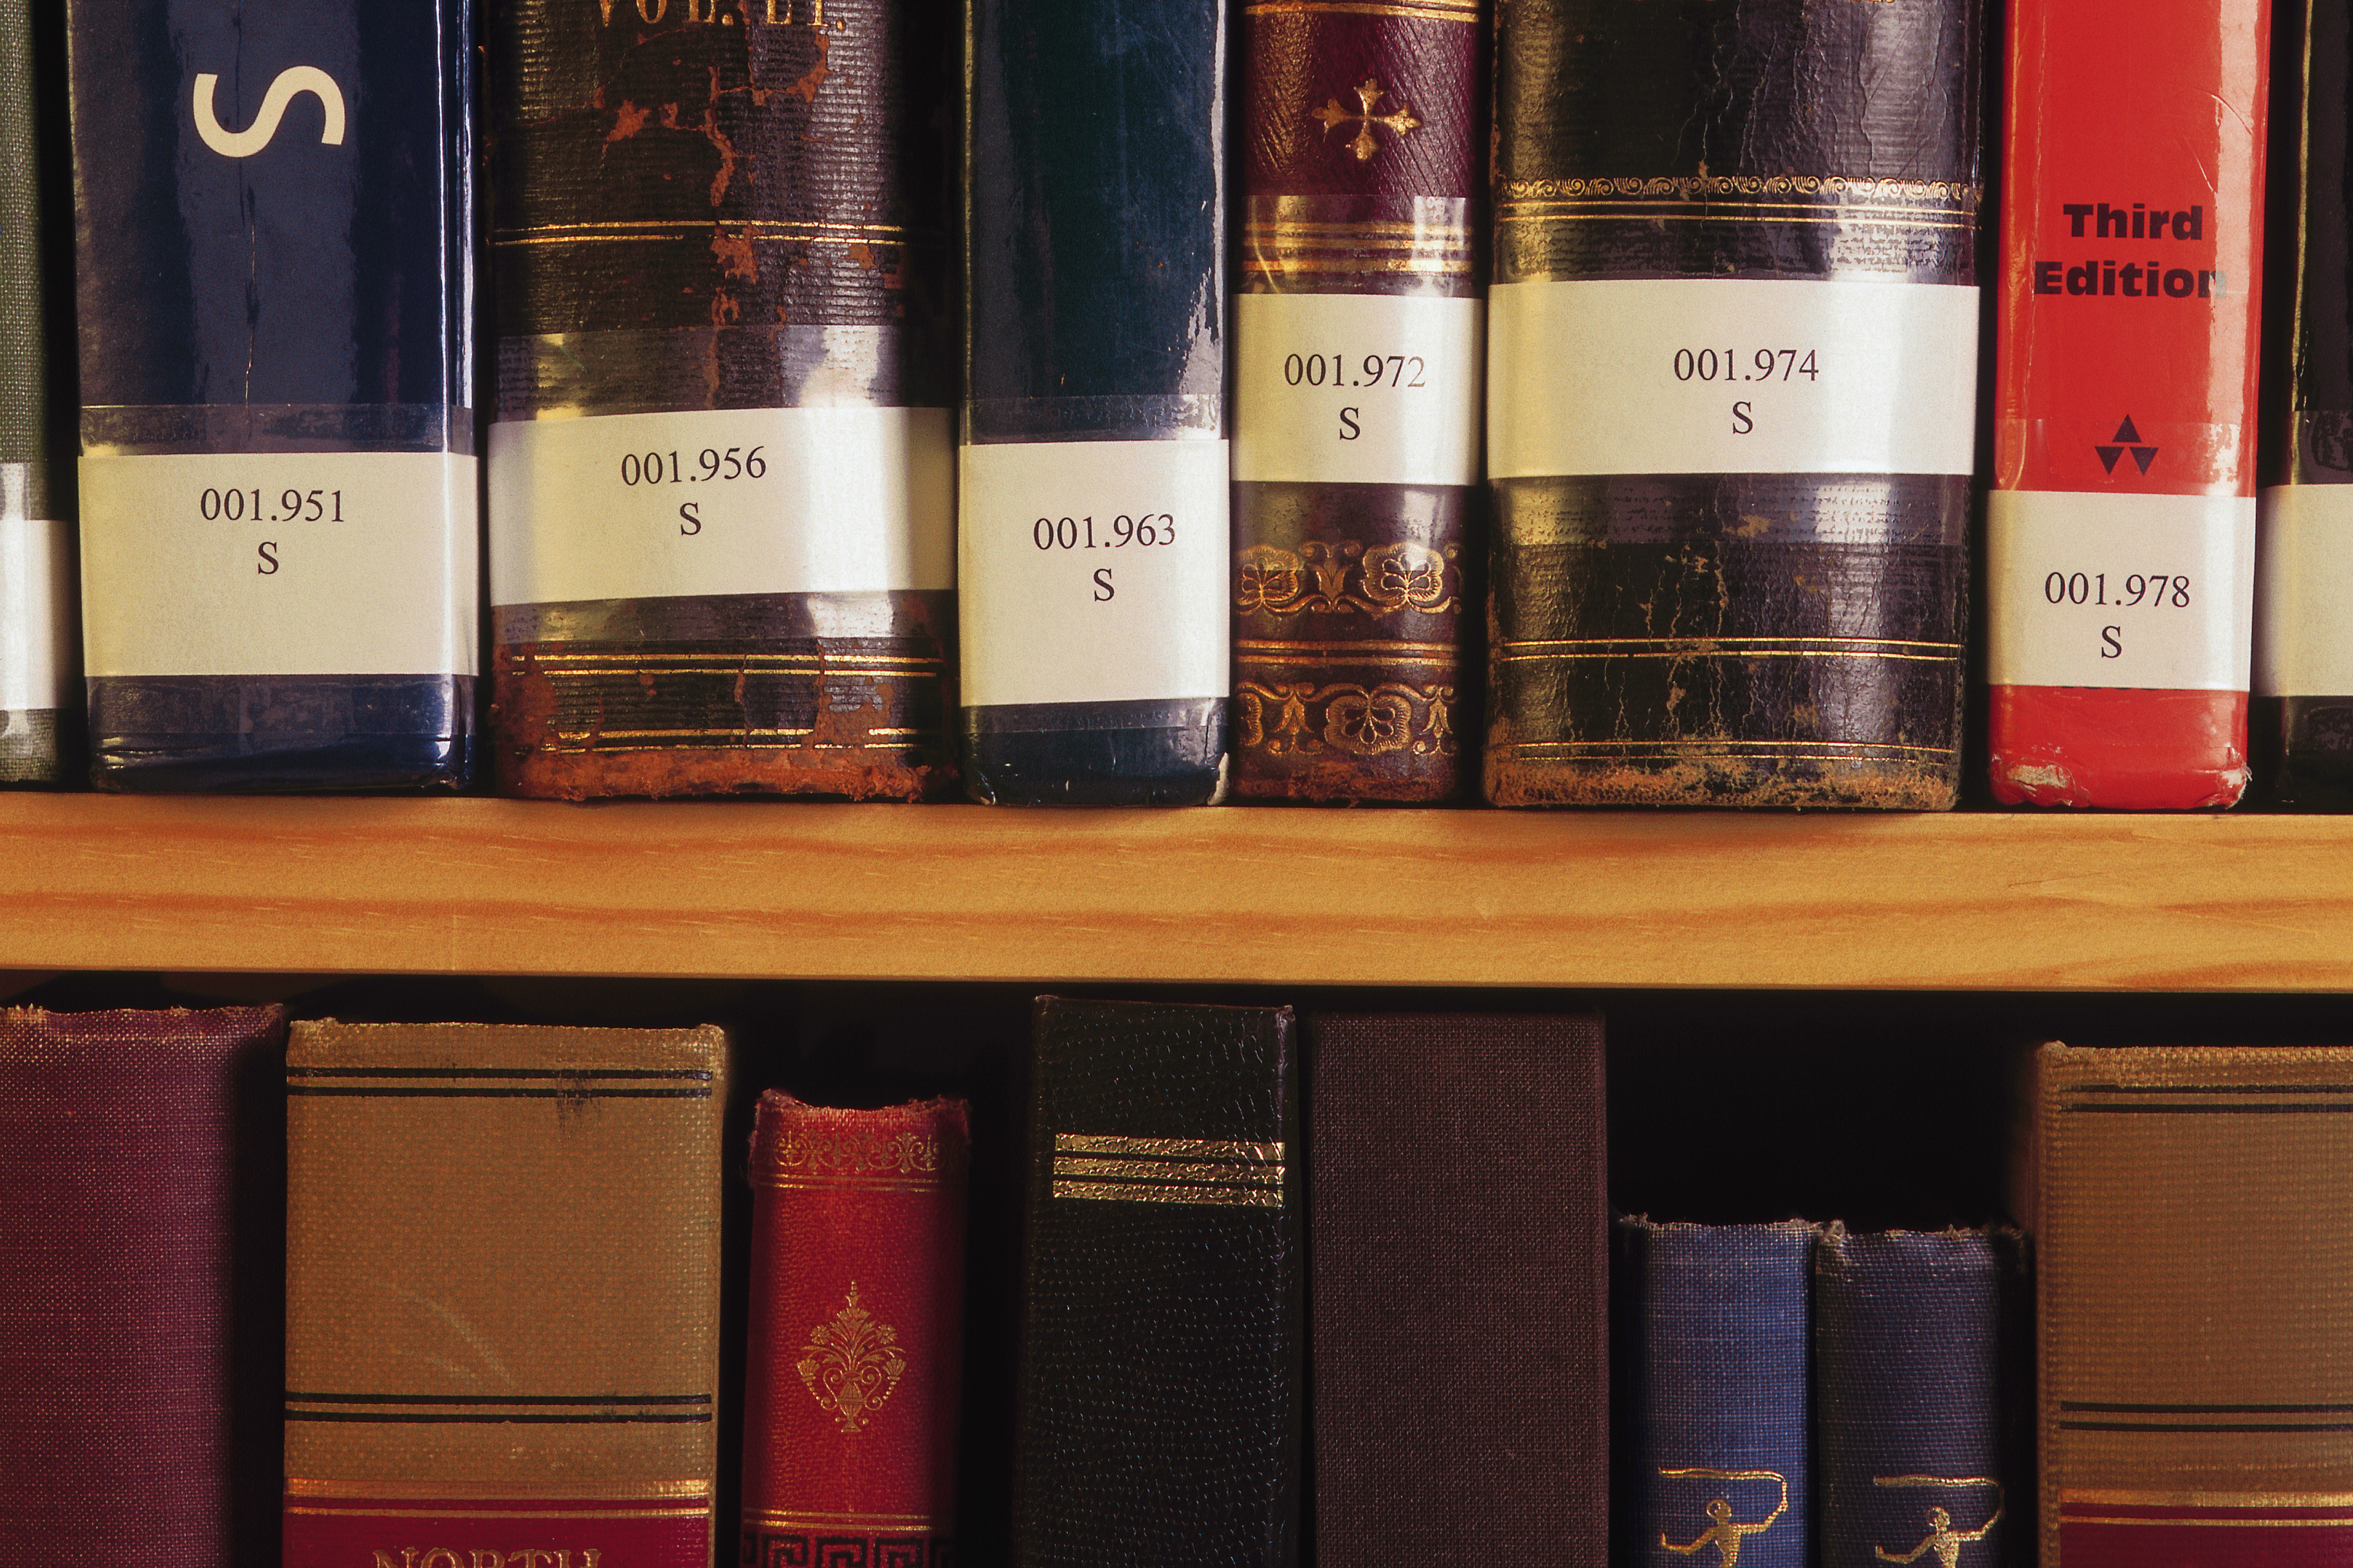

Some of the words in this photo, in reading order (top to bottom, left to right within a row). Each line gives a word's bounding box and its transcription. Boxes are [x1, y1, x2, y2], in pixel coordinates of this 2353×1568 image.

[192, 65, 346, 158] S
[2062, 203, 2203, 241] Third
[2033, 260, 2228, 298] Edition
[1284, 353, 1426, 388] 001.972
[1673, 348, 1820, 382] 001.974
[1339, 406, 1361, 441] S
[1732, 401, 1753, 435] S
[621, 445, 767, 486] 001.956
[200, 488, 344, 523] 001.951
[679, 502, 702, 536] S
[1033, 513, 1175, 551] 001.963
[257, 541, 279, 575] S
[1093, 568, 1115, 602] S
[2044, 571, 2190, 608] 001.978
[2101, 625, 2123, 659] S
